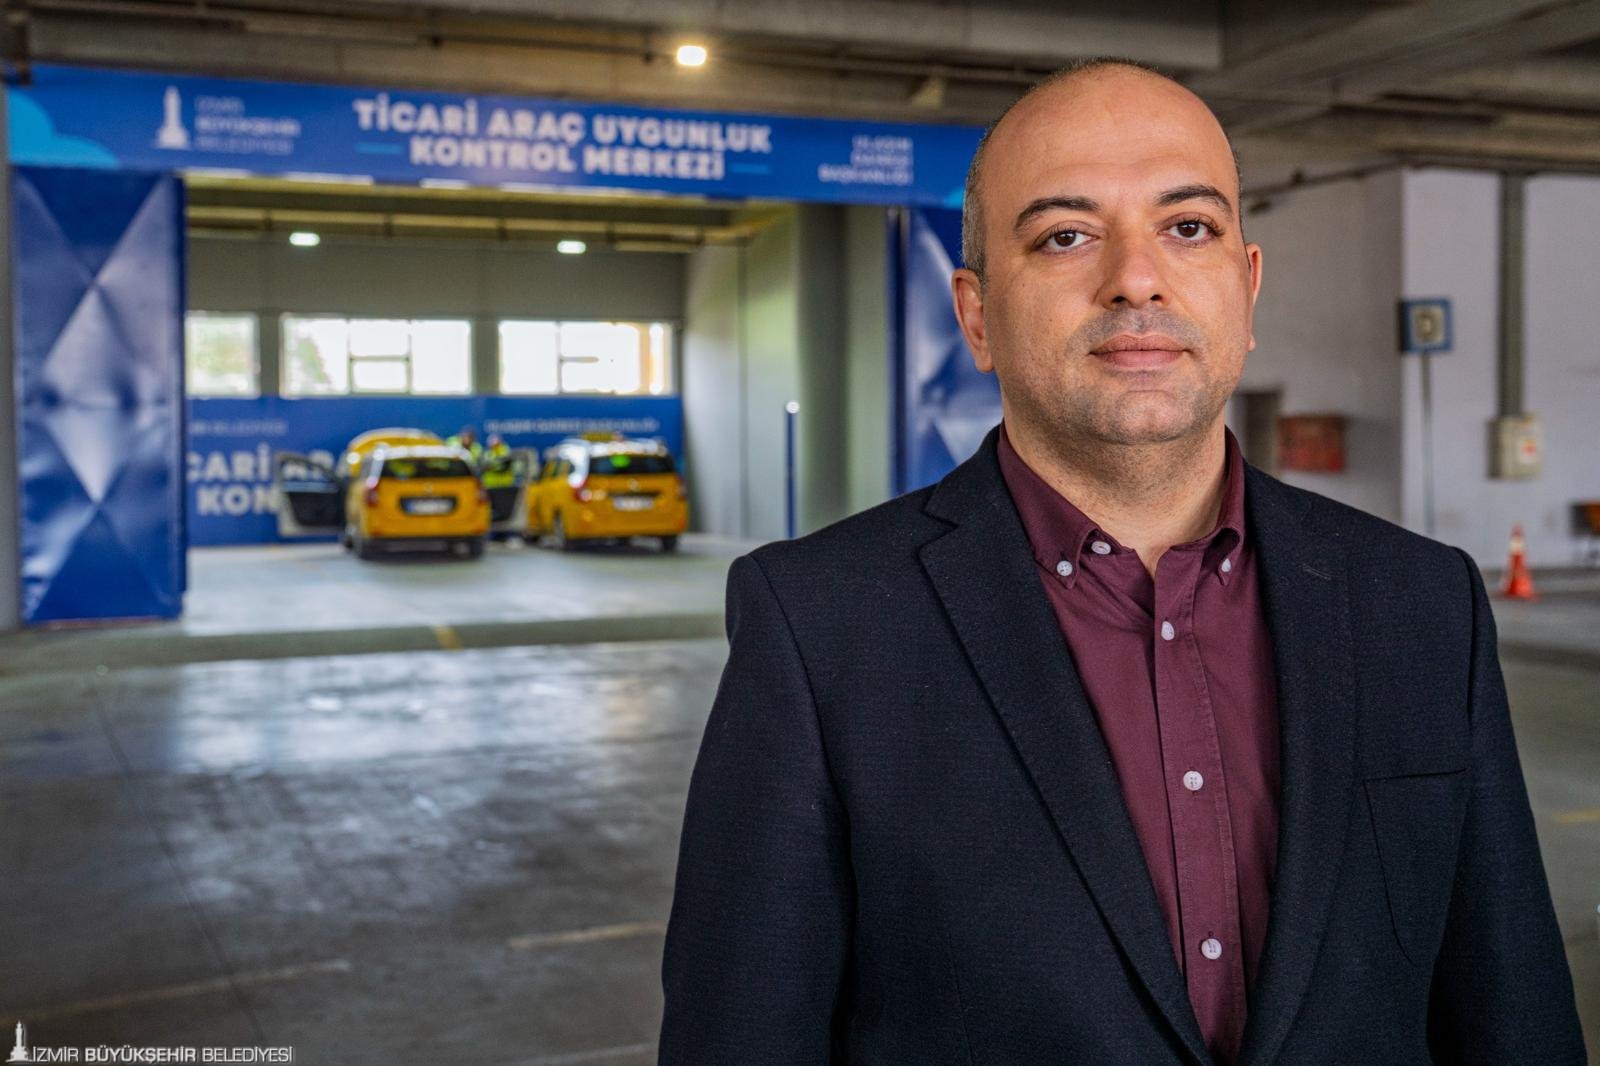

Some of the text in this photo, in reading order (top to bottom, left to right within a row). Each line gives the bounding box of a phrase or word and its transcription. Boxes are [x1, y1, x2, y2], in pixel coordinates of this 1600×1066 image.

[353, 93, 772, 153] TİCARİ ARAÇ UYGUNLUK
[410, 136, 725, 181] KONTROL MERKEZİ
